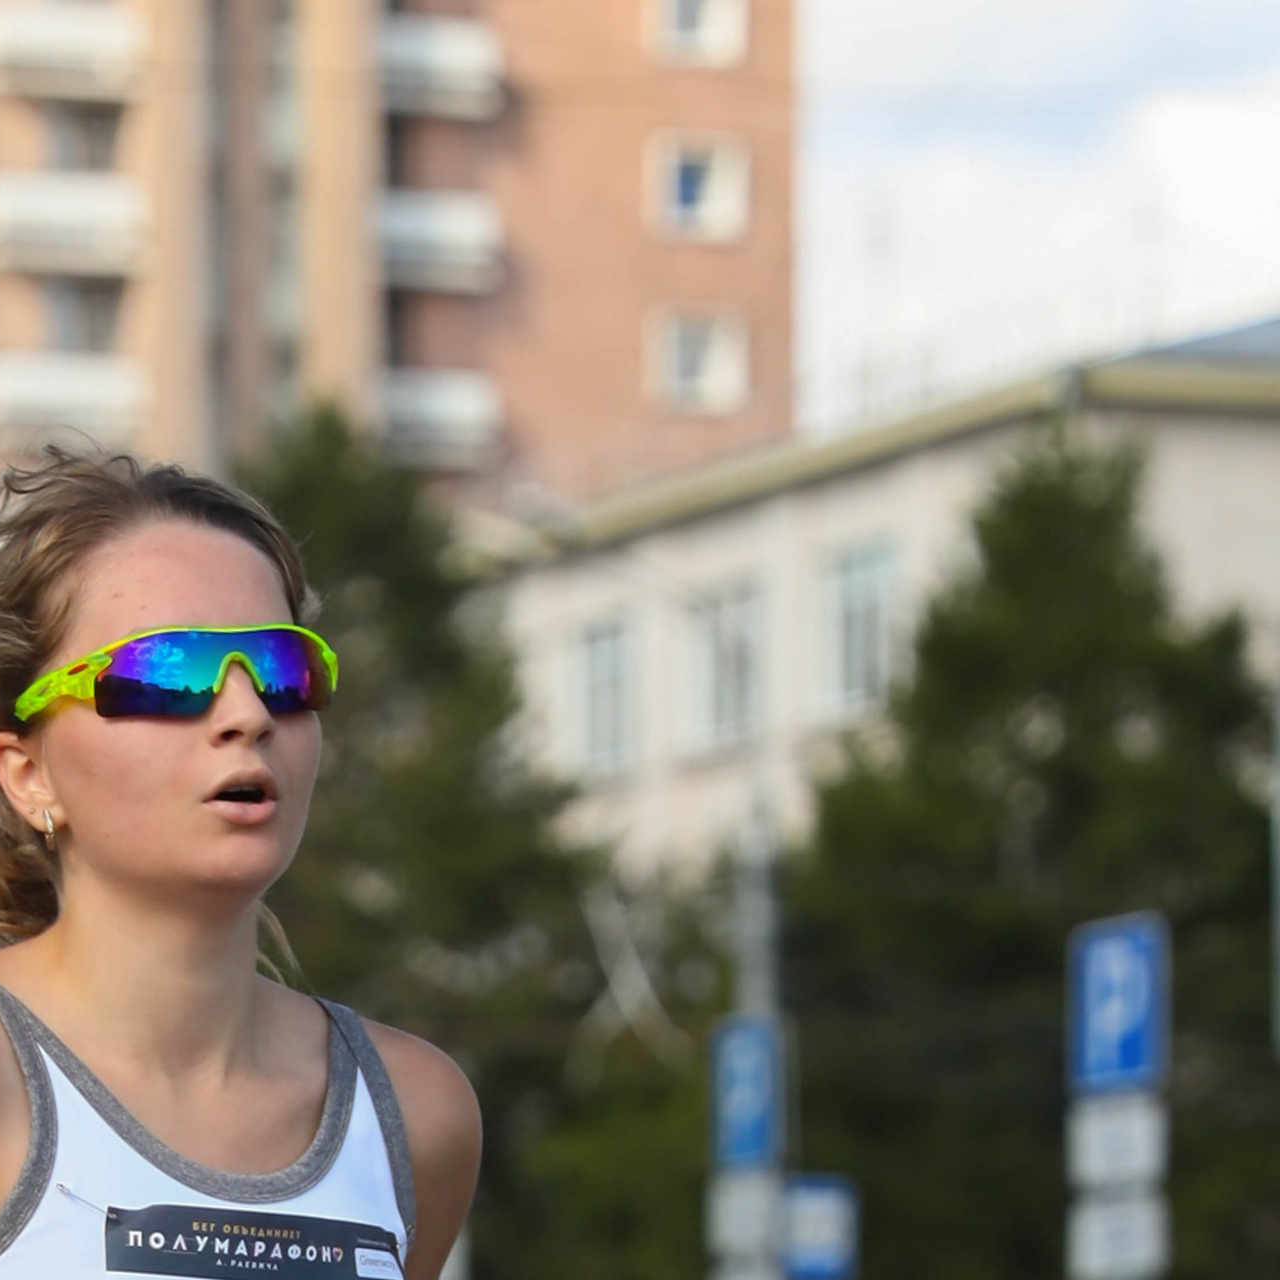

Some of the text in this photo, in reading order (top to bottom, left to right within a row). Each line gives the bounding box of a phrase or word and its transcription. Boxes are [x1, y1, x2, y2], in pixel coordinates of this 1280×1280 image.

[192, 1221, 301, 1239] БЕГ ОБЪЕДИНЯЕТ
[128, 1230, 332, 1263] ПОЛУМАРАФОН
